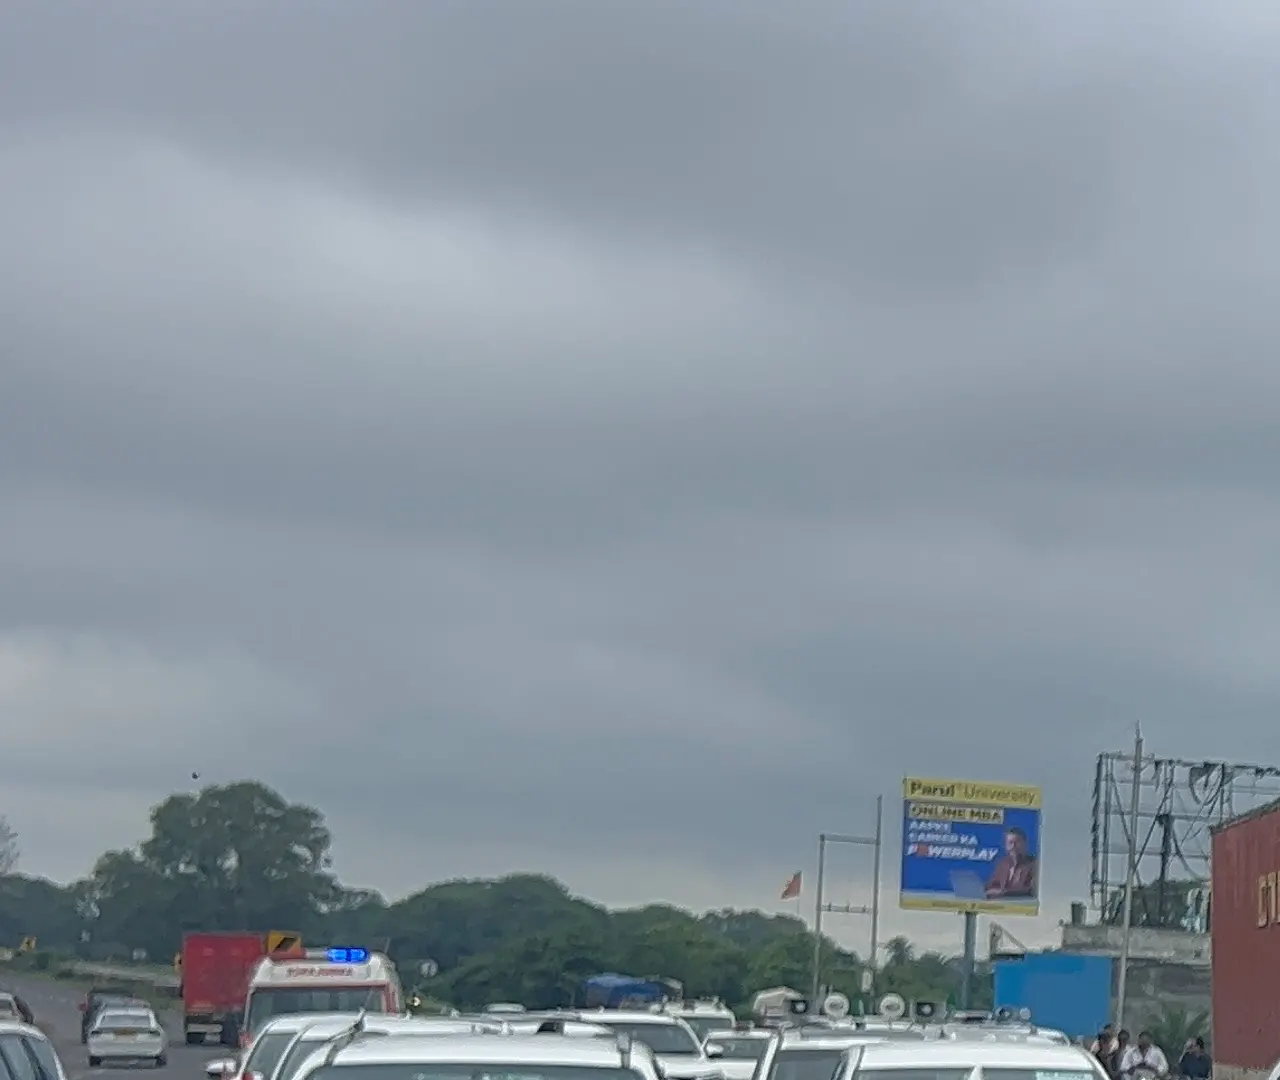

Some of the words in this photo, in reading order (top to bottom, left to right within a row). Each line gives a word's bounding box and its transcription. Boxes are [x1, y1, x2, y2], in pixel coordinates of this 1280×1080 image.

[910, 780, 955, 797] Parul
[964, 784, 1036, 804] University
[906, 843, 1000, 862] POWERPLAY
